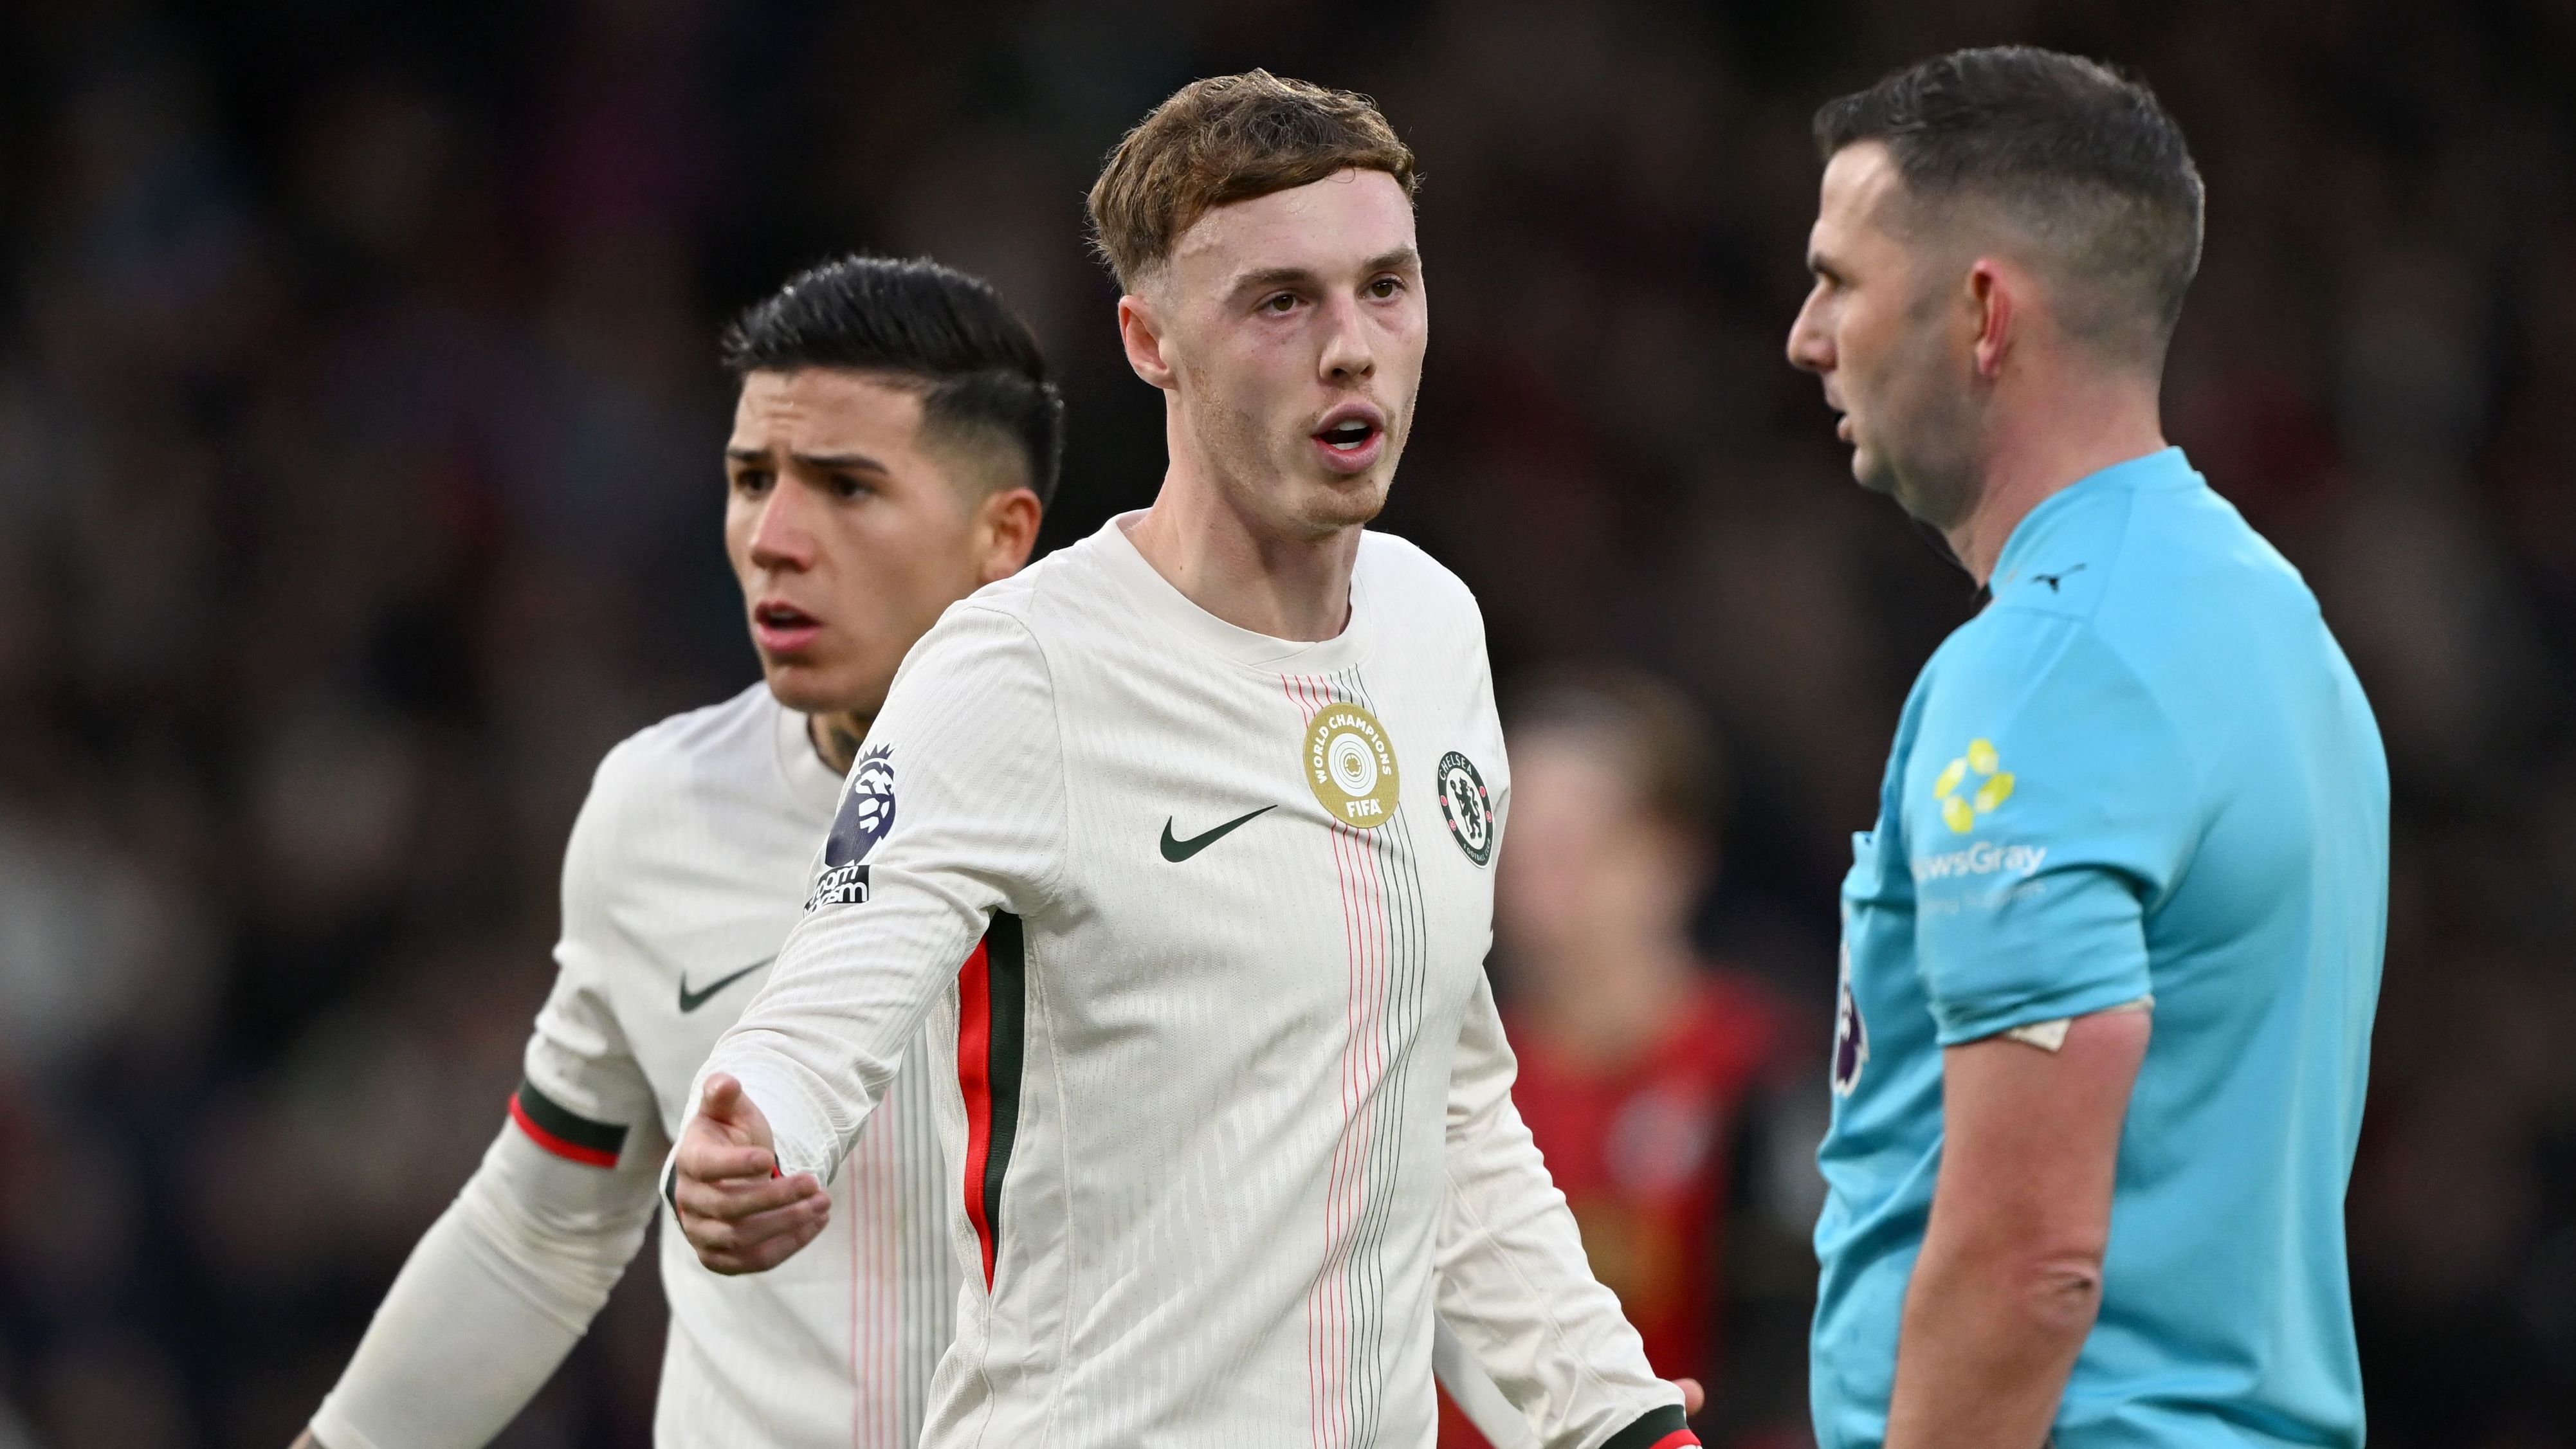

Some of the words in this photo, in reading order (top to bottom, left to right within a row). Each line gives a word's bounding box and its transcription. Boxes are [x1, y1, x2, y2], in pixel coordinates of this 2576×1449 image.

[1313, 726, 1329, 784] WORLD
[1329, 714, 1391, 776] CHAMPIONS
[1439, 754, 1472, 781] CHELSEA
[1346, 799, 1382, 817] FIFA
